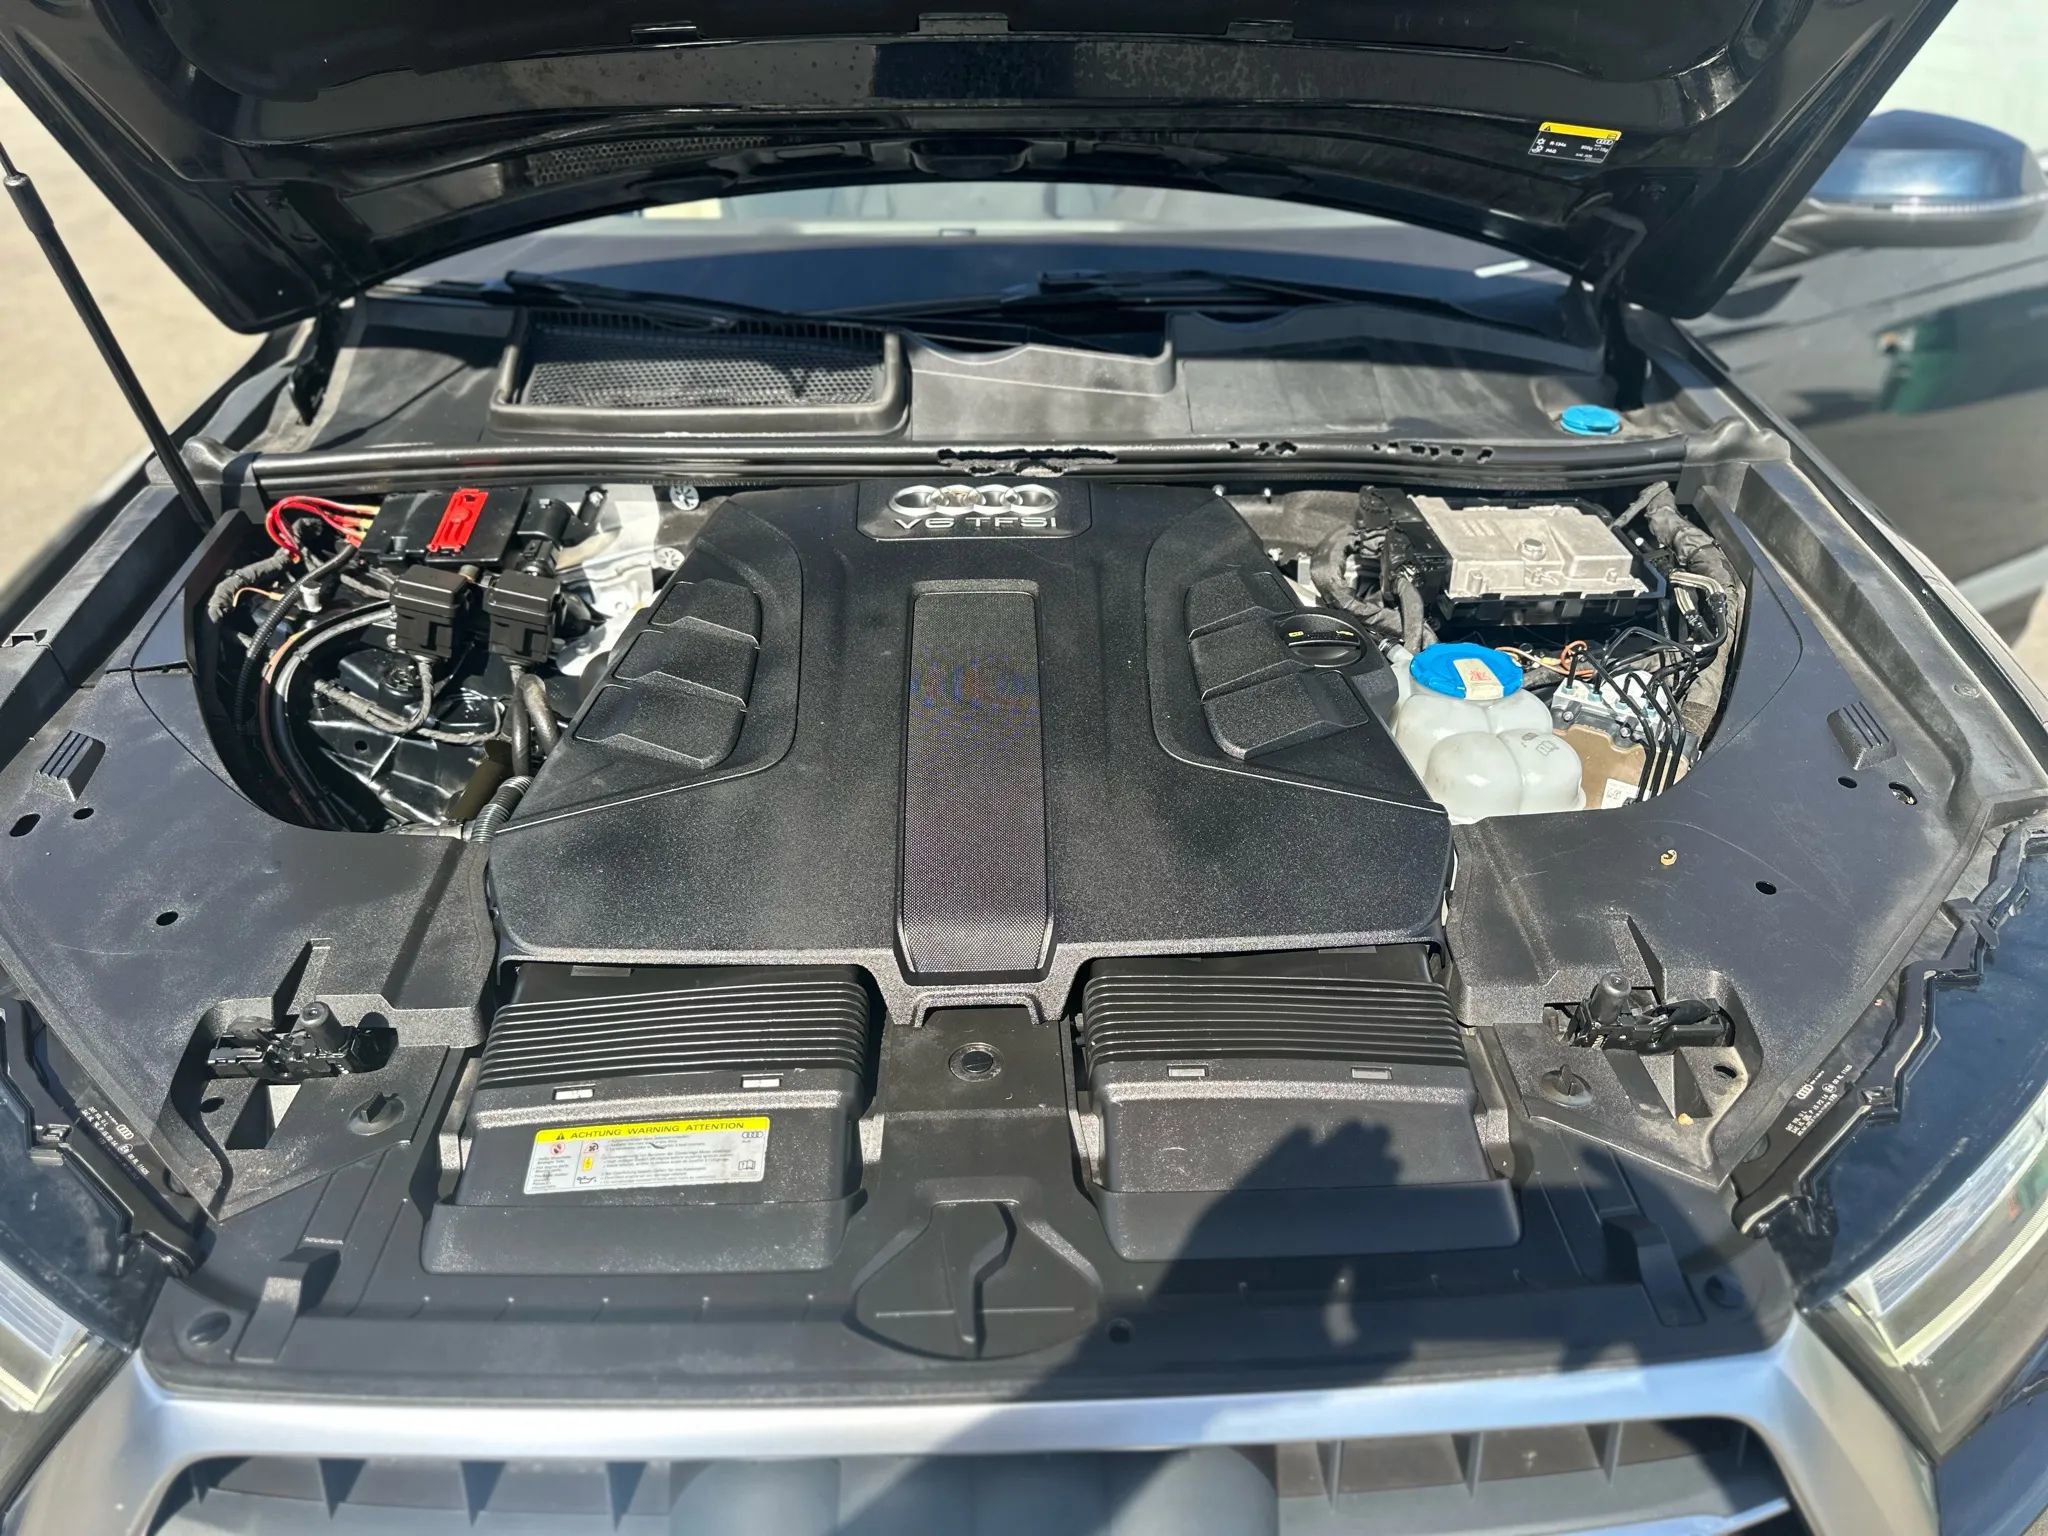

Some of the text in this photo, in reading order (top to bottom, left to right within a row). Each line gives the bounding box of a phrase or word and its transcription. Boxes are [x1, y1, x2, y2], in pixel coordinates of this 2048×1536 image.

[894, 516, 1057, 529] V6 TFSI
[570, 1128, 622, 1139] ACHTUNG
[627, 1125, 680, 1135] WARNING
[684, 1122, 744, 1131] ATTENTION
